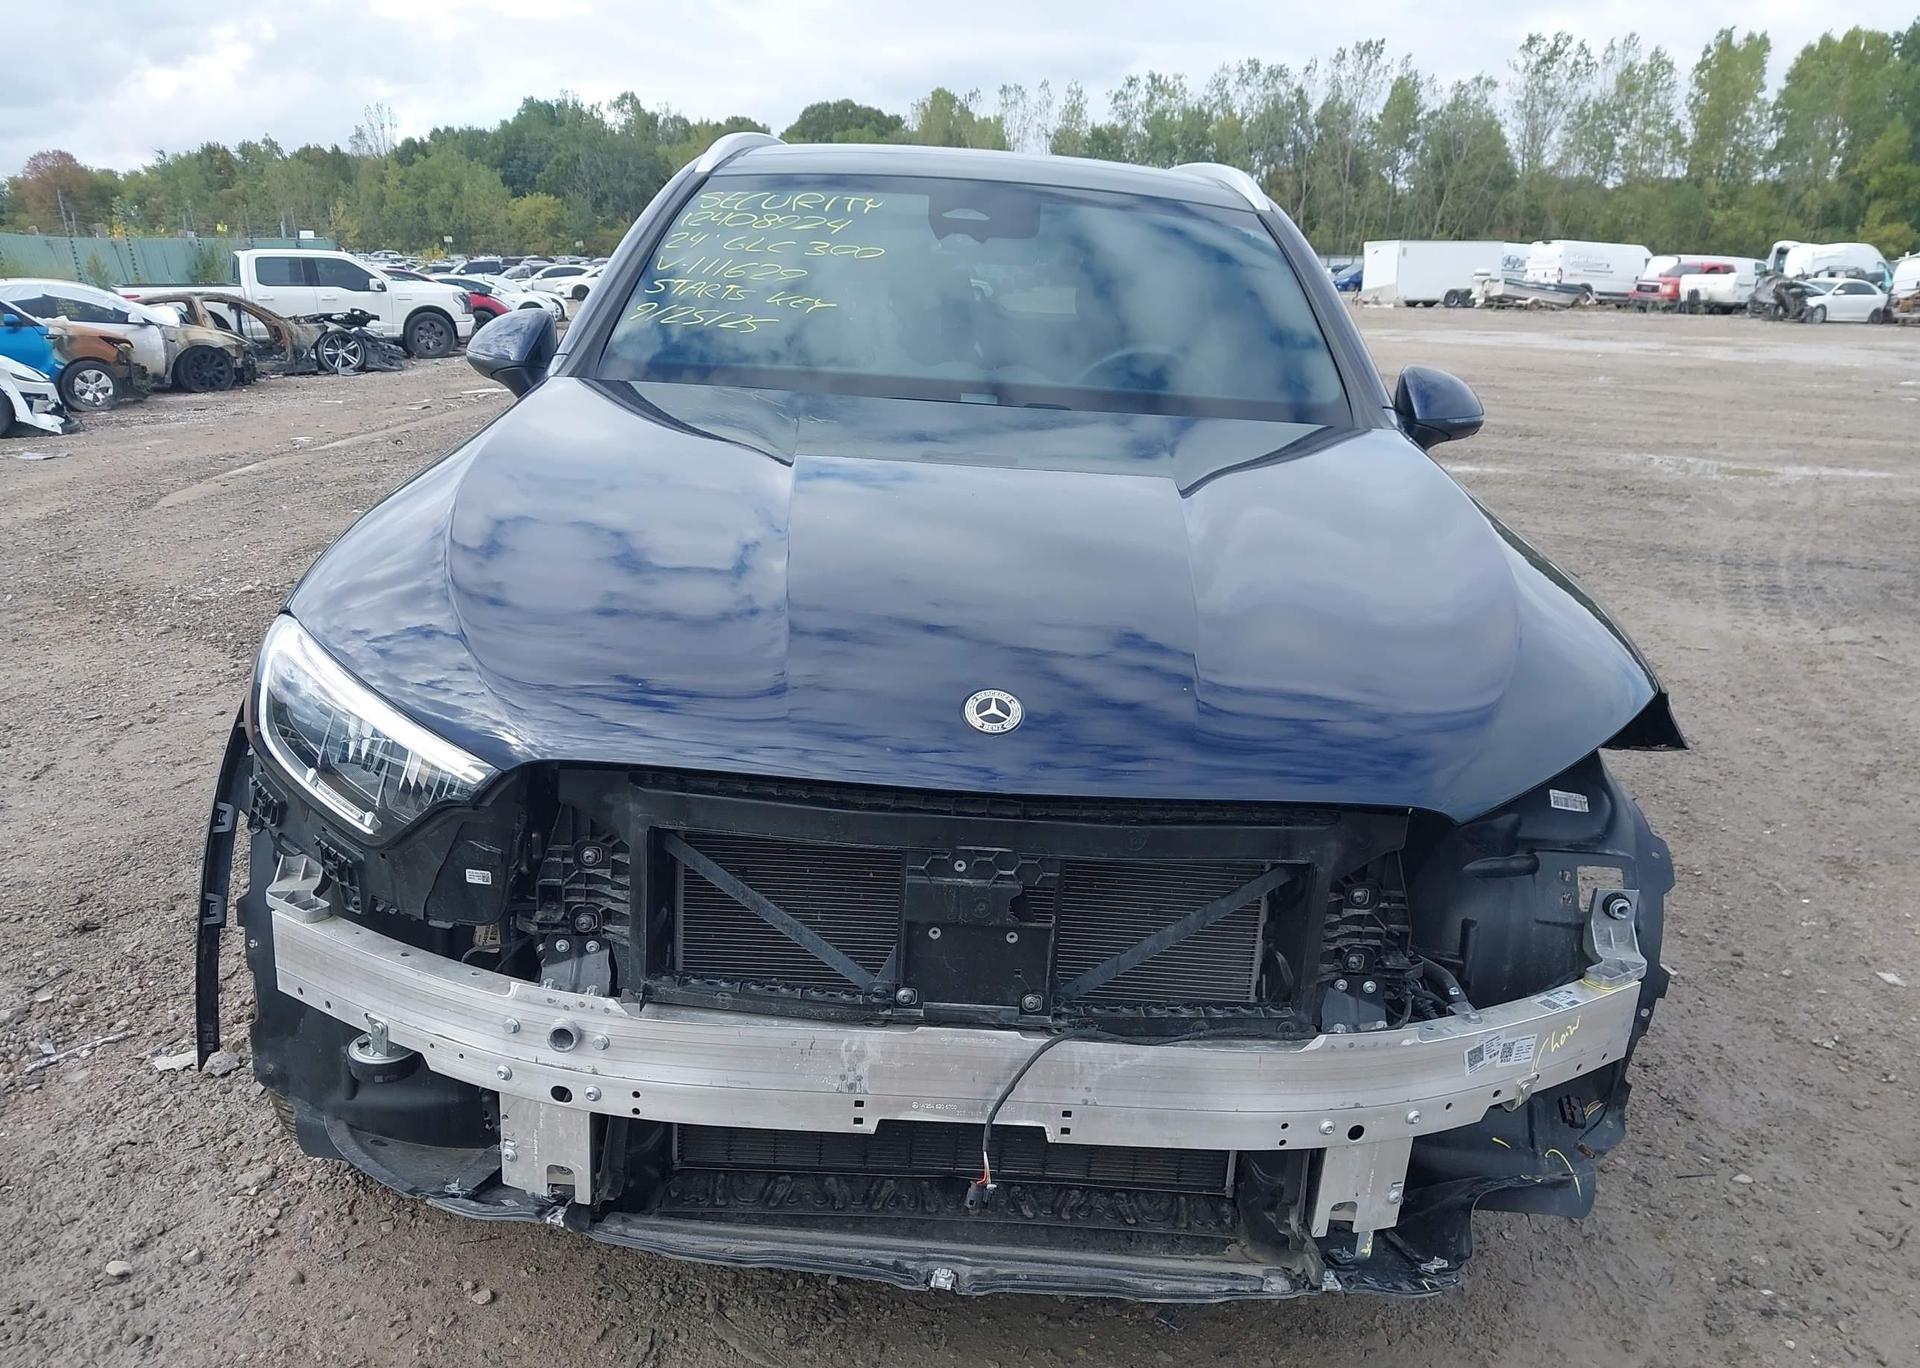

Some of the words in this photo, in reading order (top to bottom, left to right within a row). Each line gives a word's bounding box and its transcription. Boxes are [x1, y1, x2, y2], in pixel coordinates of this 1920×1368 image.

[700, 191, 884, 214] SECURITY
[723, 236, 798, 253] GLC
[804, 241, 886, 259] 300
[644, 279, 756, 301] STARTS
[766, 291, 838, 314] KEY
[629, 302, 780, 333] 9/25/25
